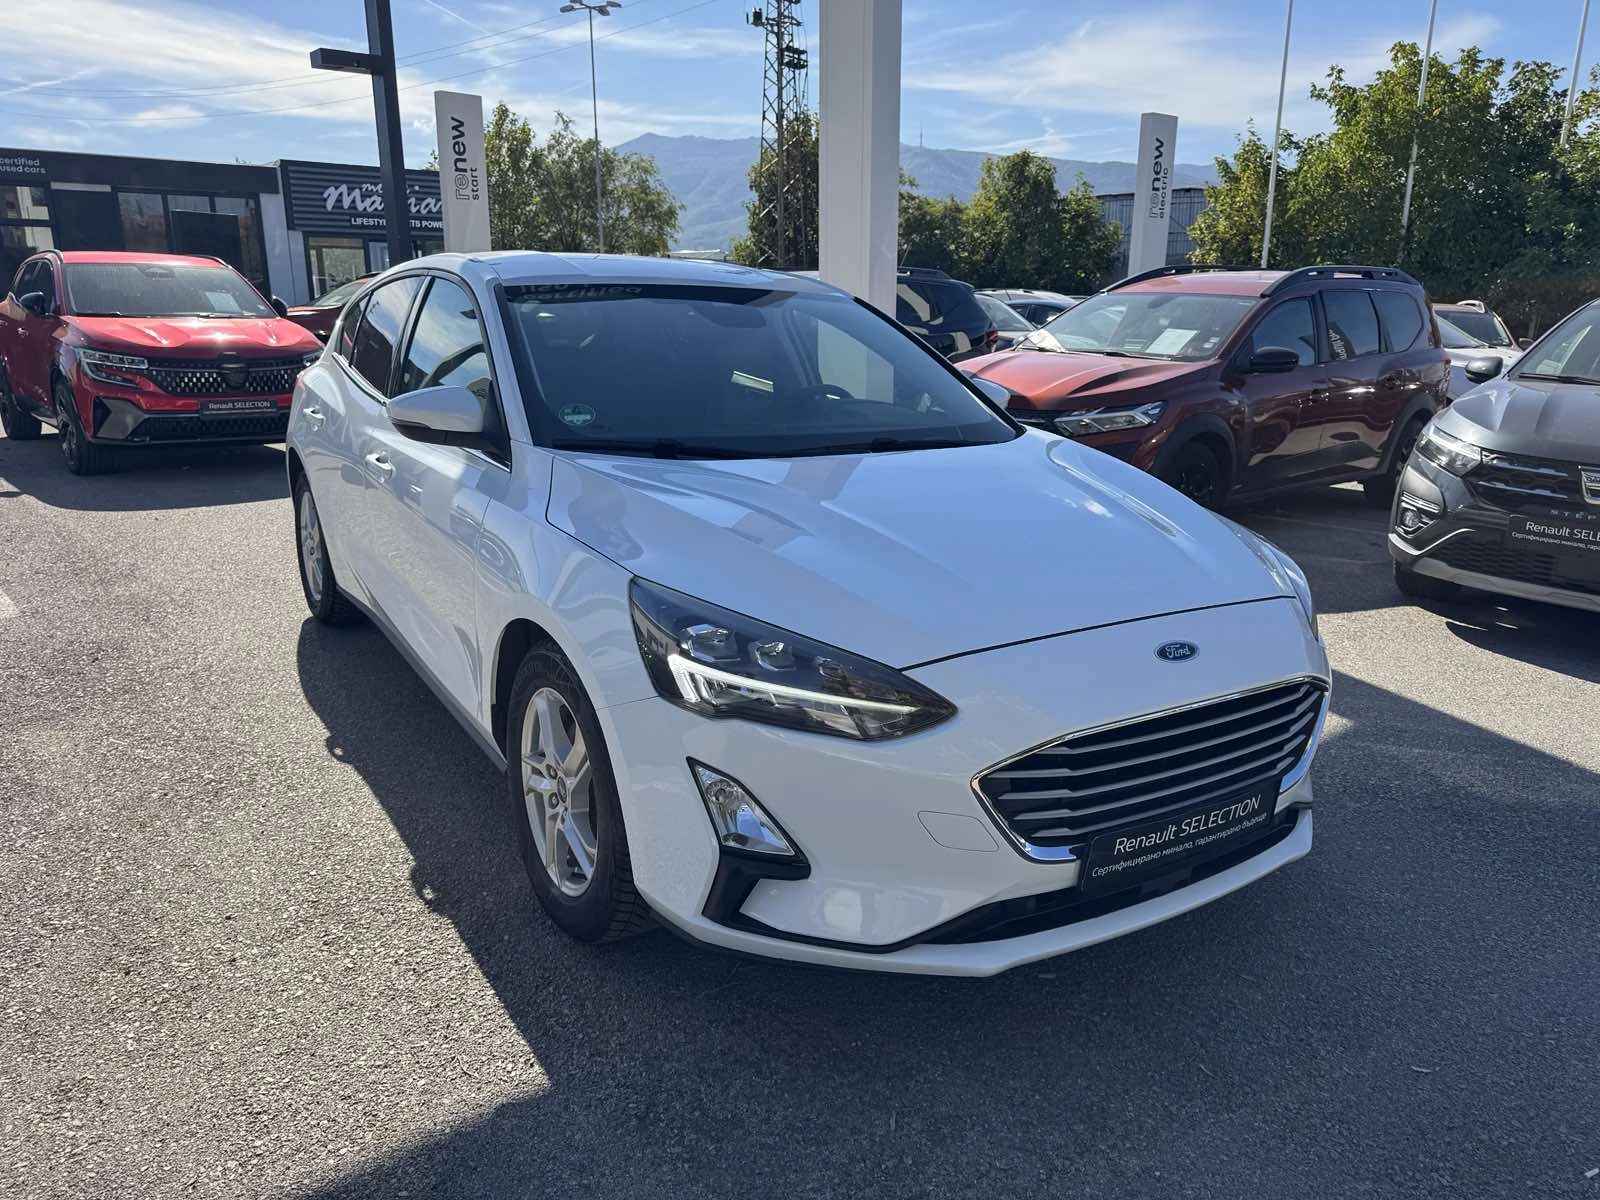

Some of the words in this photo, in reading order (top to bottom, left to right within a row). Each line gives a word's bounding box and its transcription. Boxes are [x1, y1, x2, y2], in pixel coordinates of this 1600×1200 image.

[450, 116, 470, 201] renew
[470, 166, 480, 201] start
[233, 400, 271, 408] SELECTION
[1526, 521, 1570, 537] Renault
[1113, 824, 1178, 856] Renault
[1179, 794, 1261, 837] SELECTION
